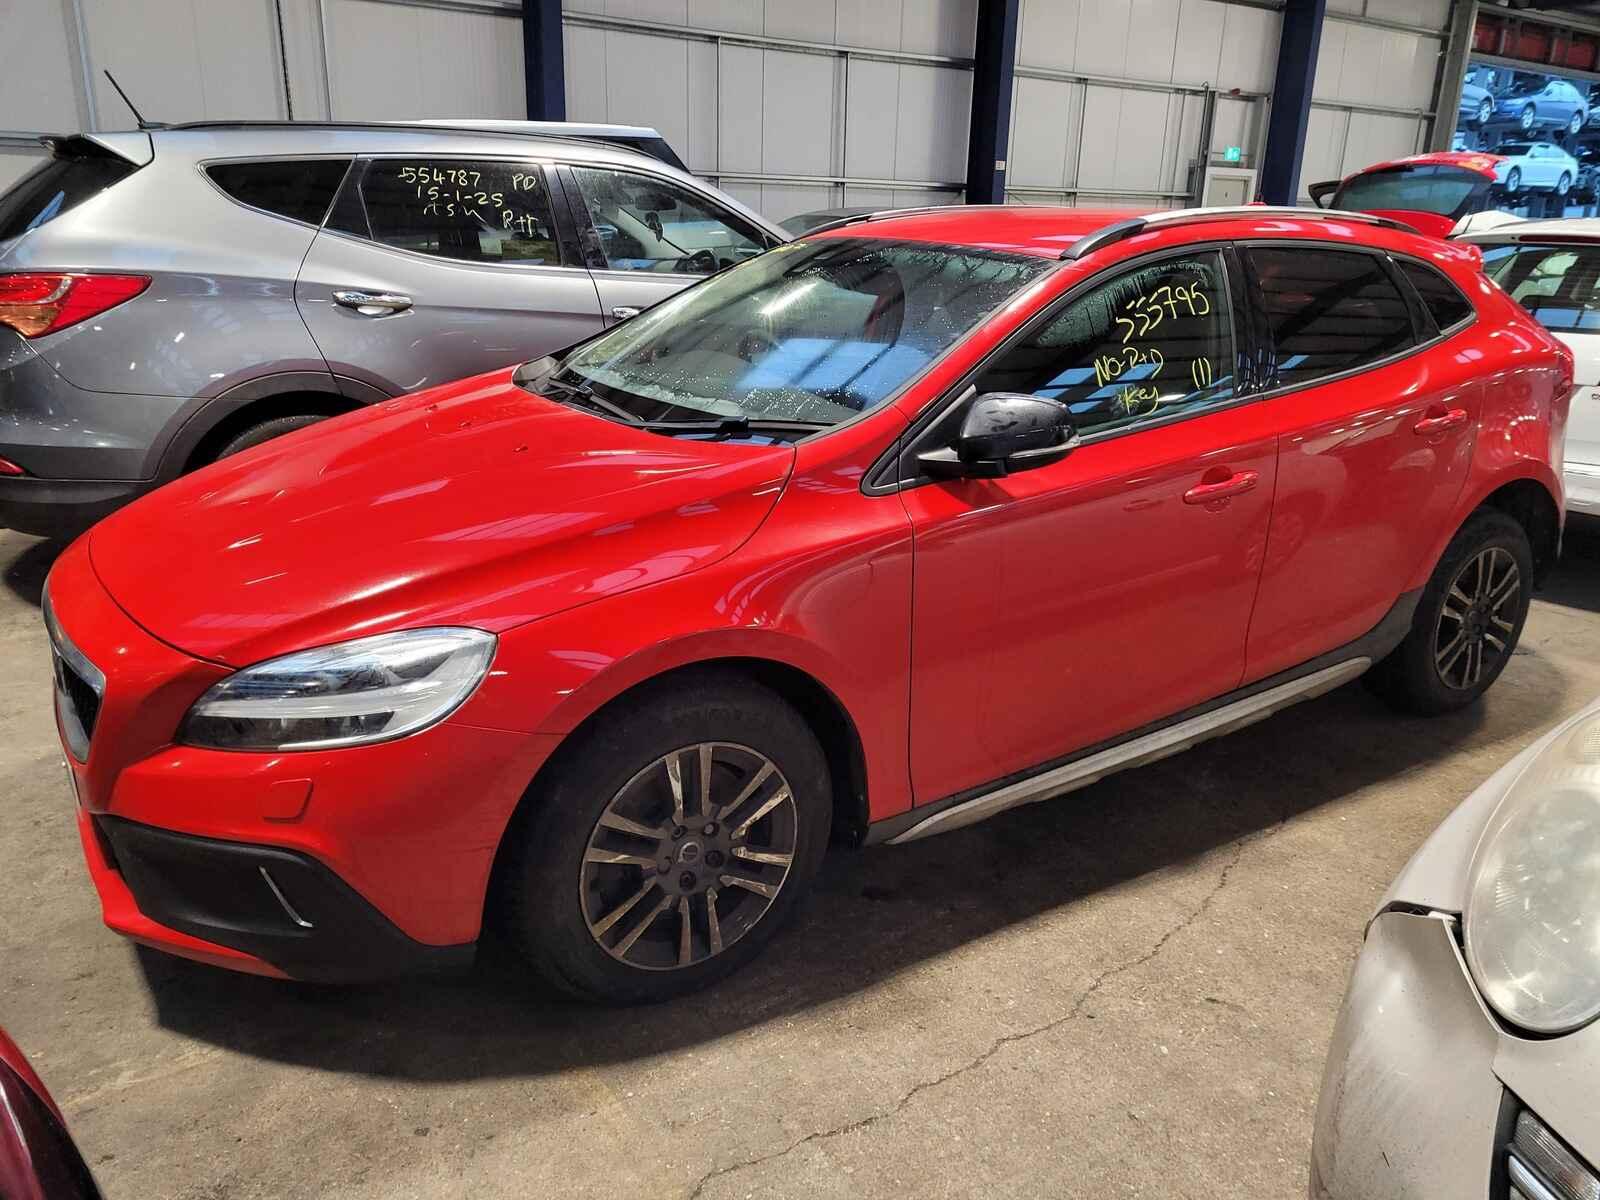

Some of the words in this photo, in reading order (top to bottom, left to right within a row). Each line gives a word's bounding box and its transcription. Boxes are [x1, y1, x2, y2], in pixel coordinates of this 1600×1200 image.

[398, 167, 481, 188] 554787
[417, 184, 504, 208] 15-1-25
[1115, 281, 1210, 344] 555795
